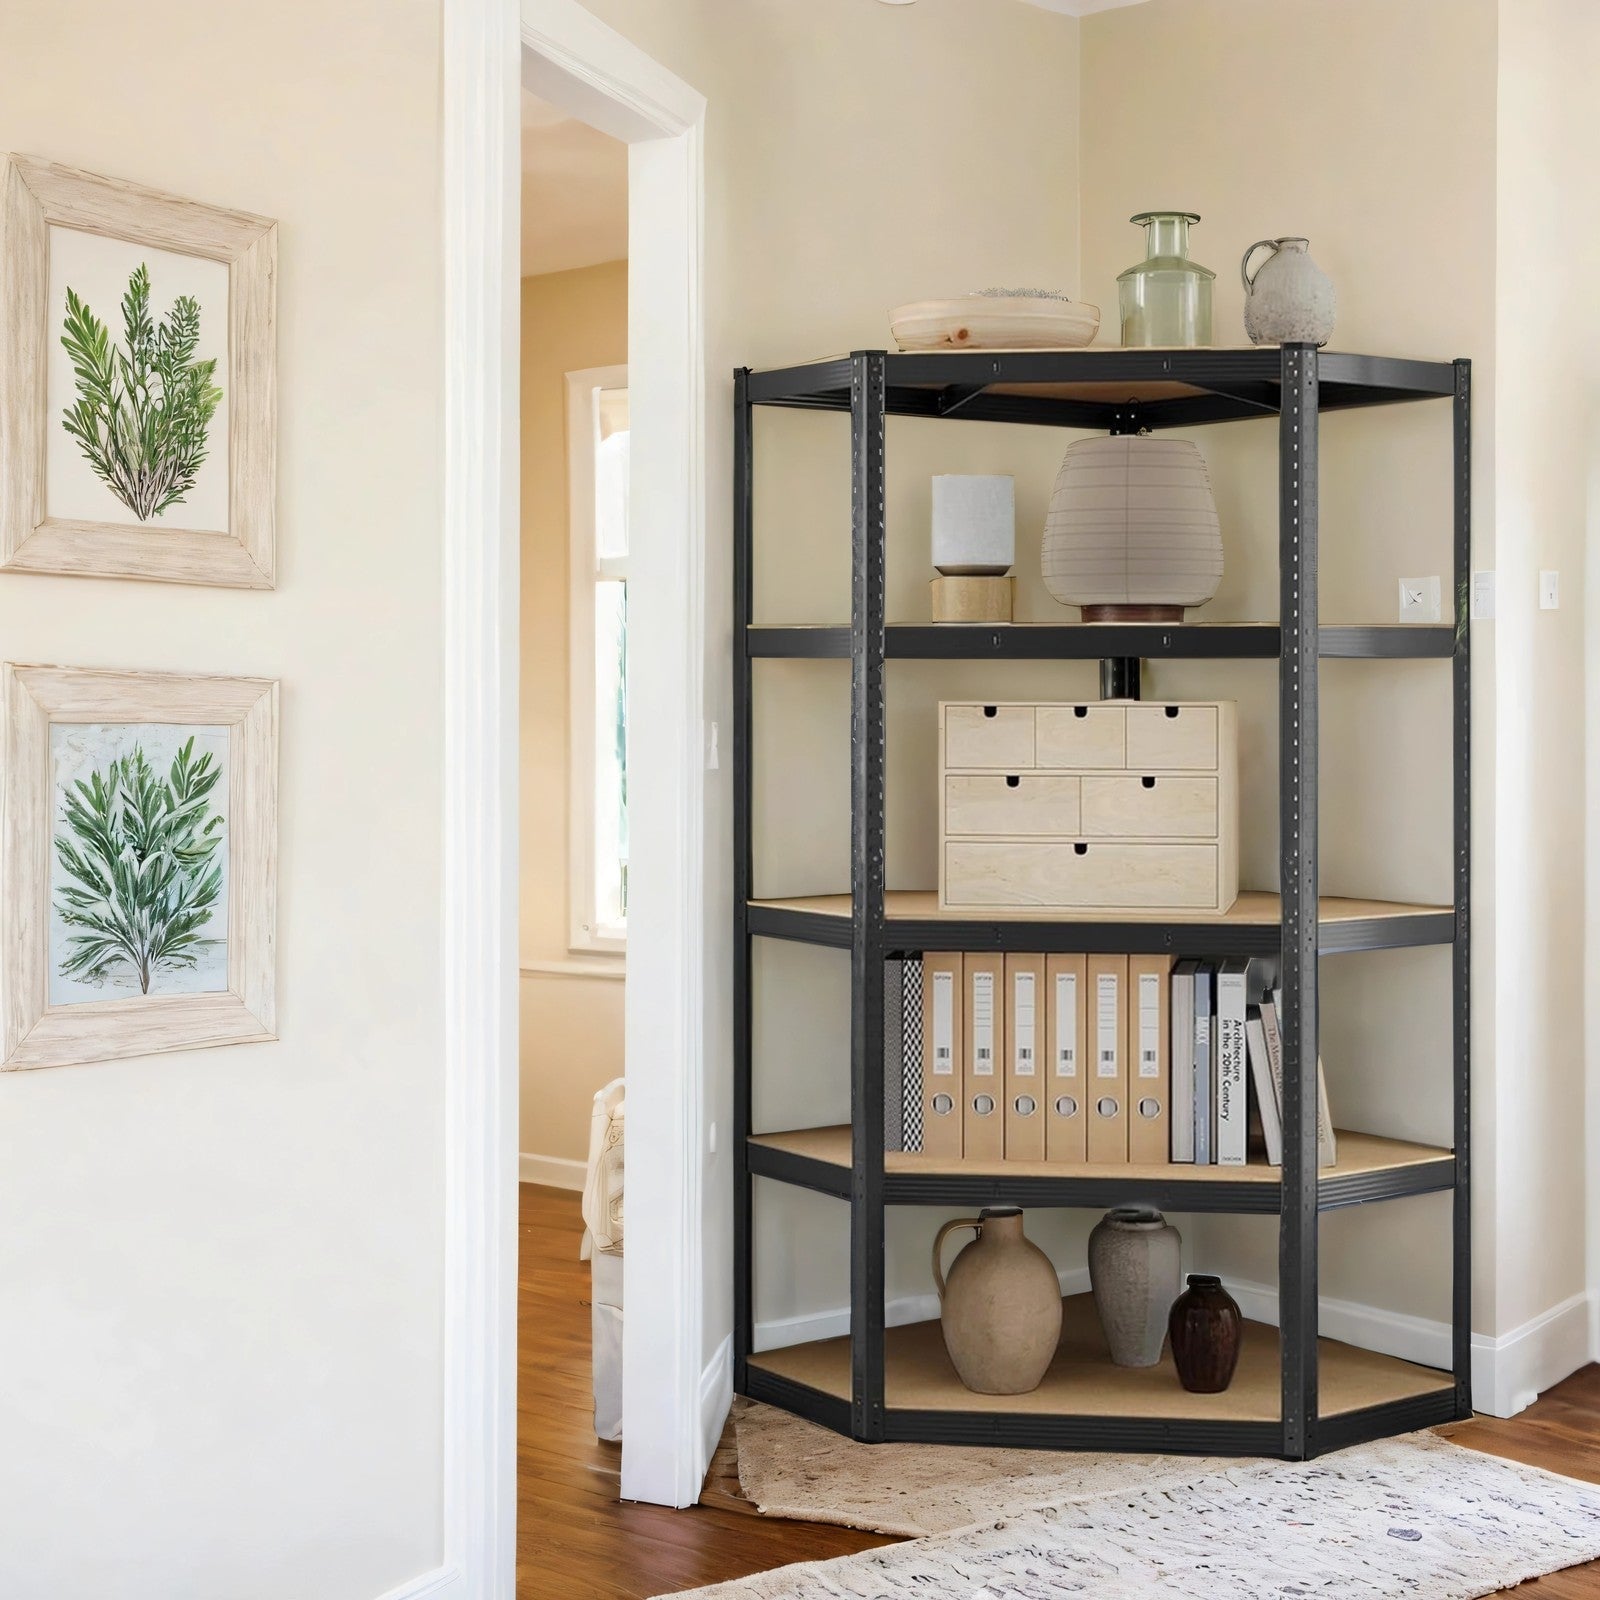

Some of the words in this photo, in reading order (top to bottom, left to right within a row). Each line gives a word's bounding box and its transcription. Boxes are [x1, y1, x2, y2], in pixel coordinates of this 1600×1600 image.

[1222, 1019, 1232, 1030] in
[1222, 1032, 1232, 1049] the
[1233, 1019, 1243, 1082] Architecture
[1222, 1052, 1232, 1077] 20th
[1220, 1079, 1232, 1121] Century
